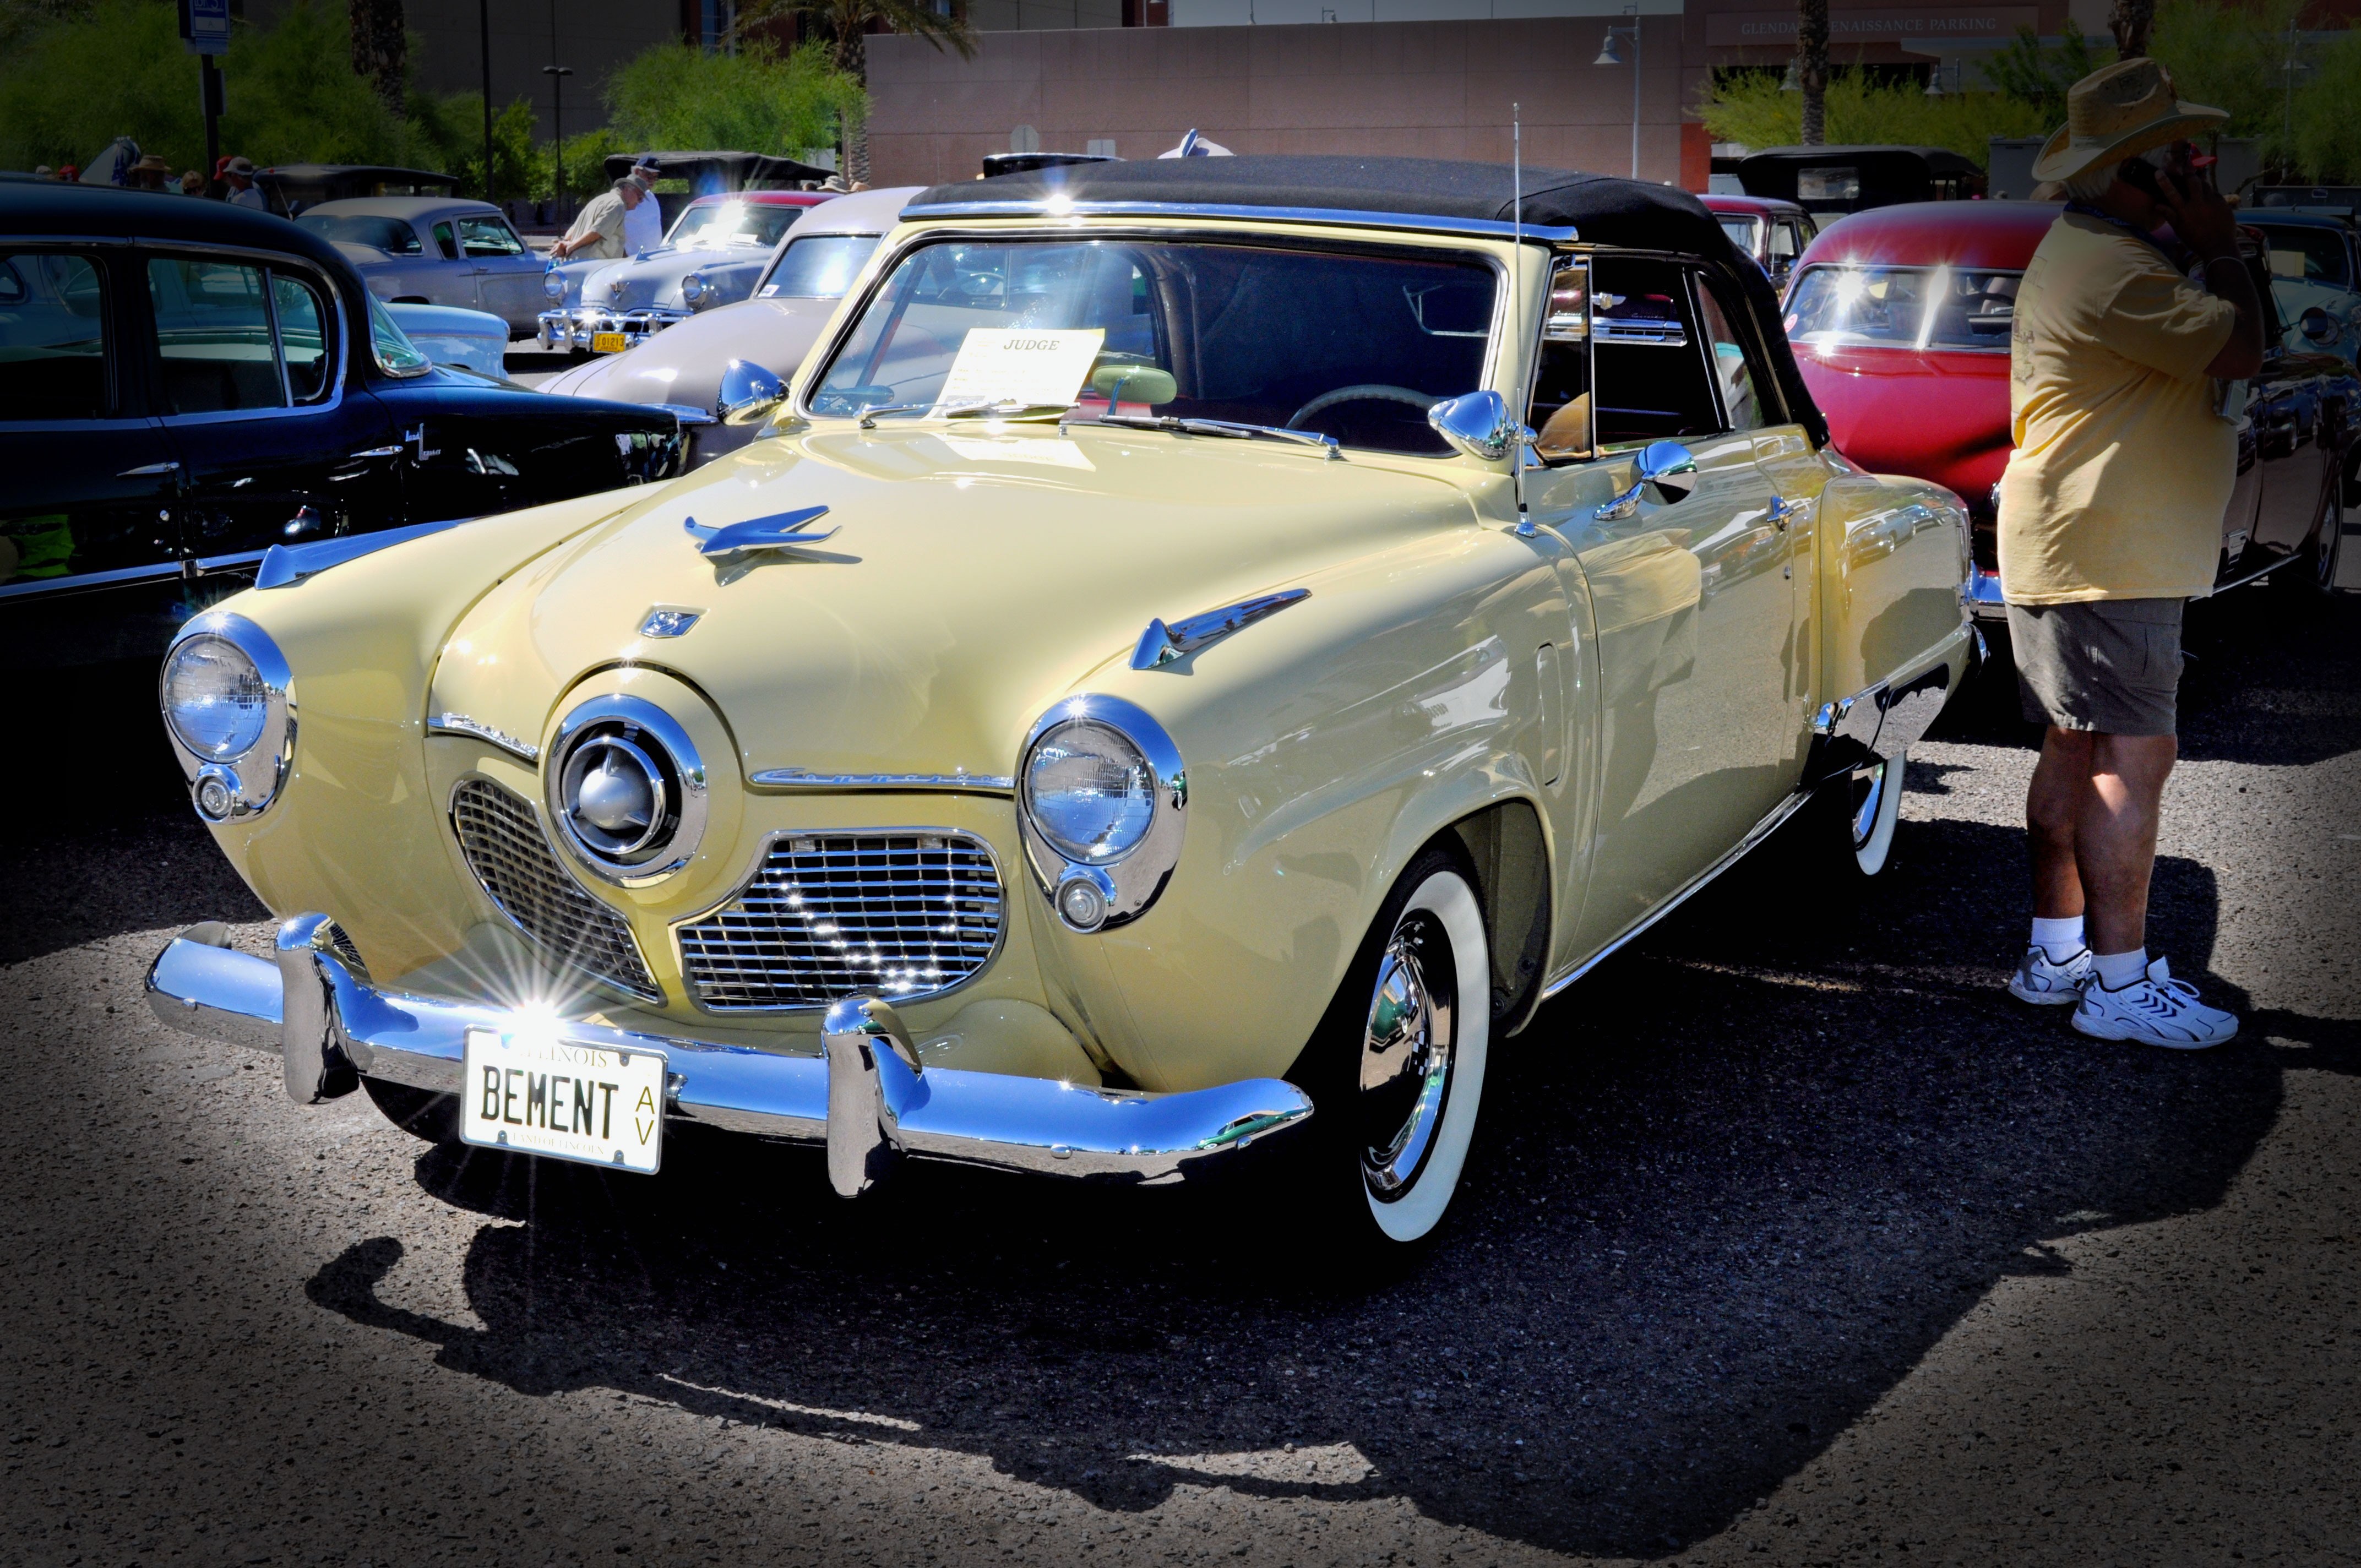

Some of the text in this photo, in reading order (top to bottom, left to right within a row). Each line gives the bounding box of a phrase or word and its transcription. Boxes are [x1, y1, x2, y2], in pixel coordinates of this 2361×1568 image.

[1742, 18, 1996, 34] GLENDA ENAISSANCE PARKING
[602, 337, 624, 346] 01213
[1003, 339, 1060, 351] JUDGE
[520, 1046, 607, 1068] LLINOIS
[481, 1065, 619, 1140] BEMENT
